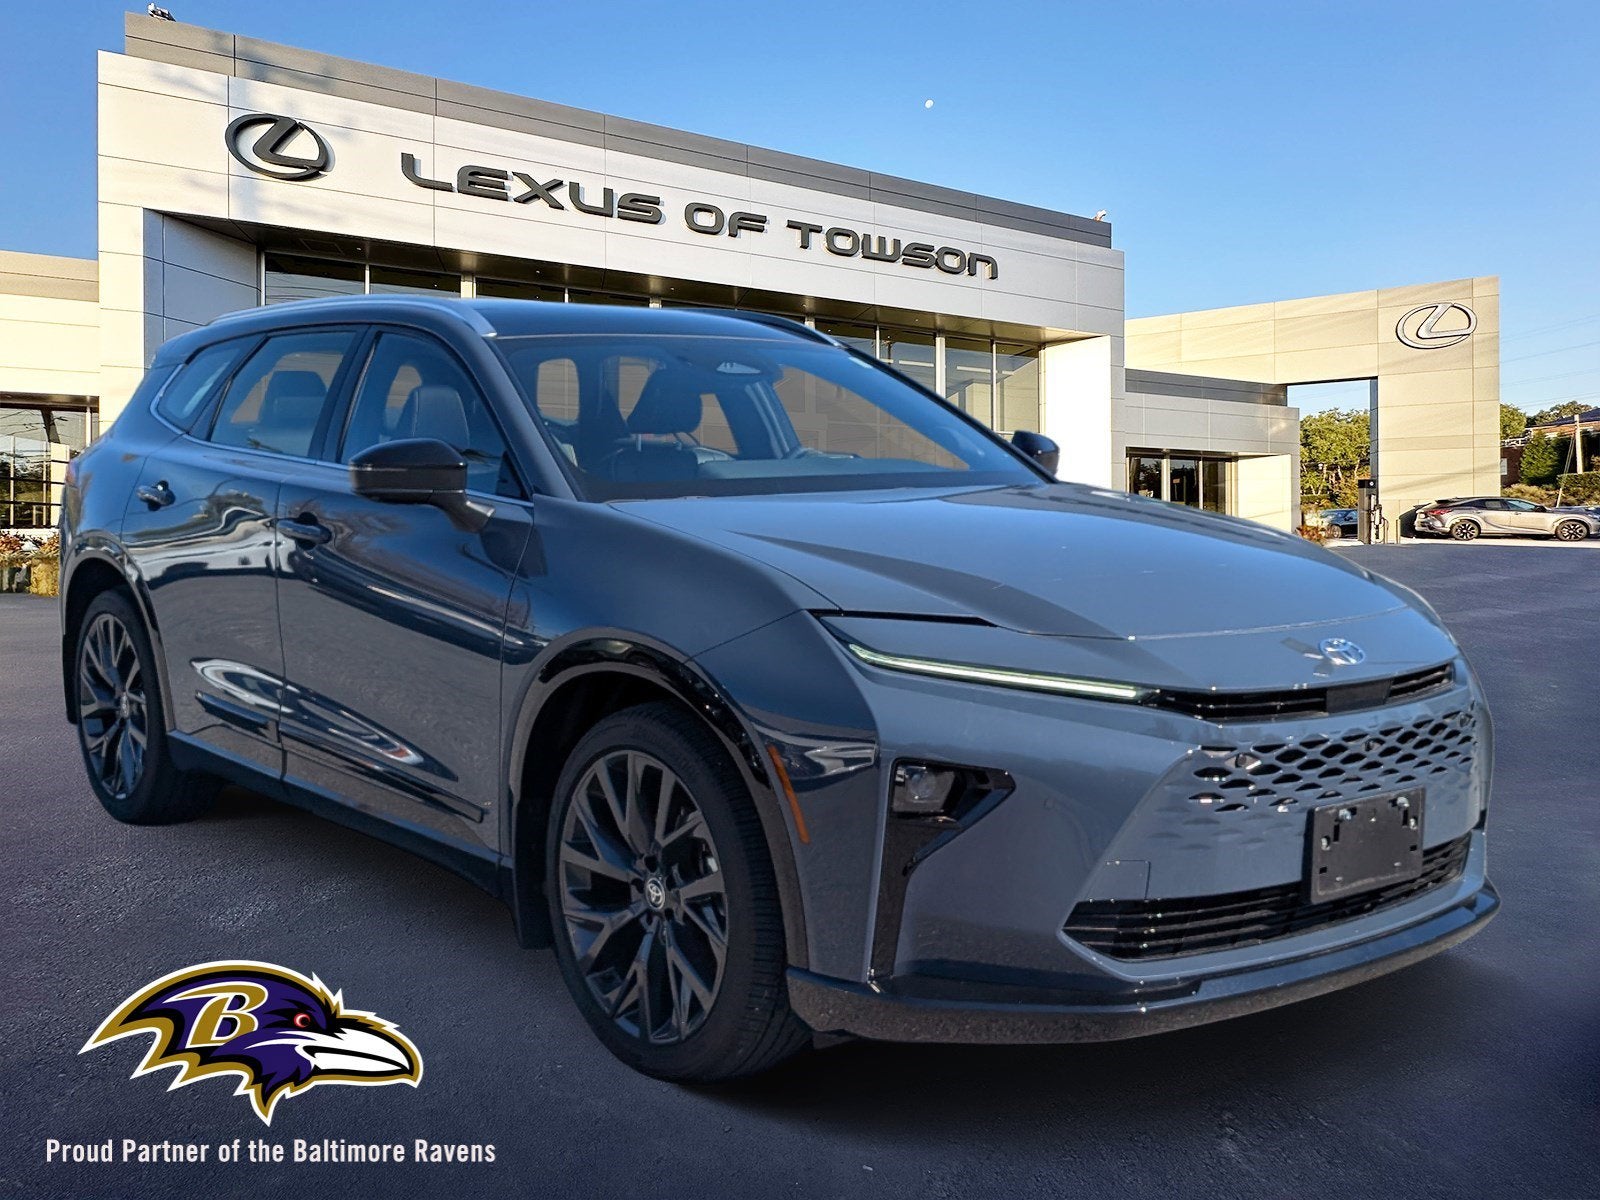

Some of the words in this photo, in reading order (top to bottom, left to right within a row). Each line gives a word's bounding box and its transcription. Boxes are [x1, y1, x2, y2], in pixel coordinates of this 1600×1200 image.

[401, 152, 662, 225] LEXUS
[685, 202, 767, 238] OF
[787, 219, 999, 280] TOWSON
